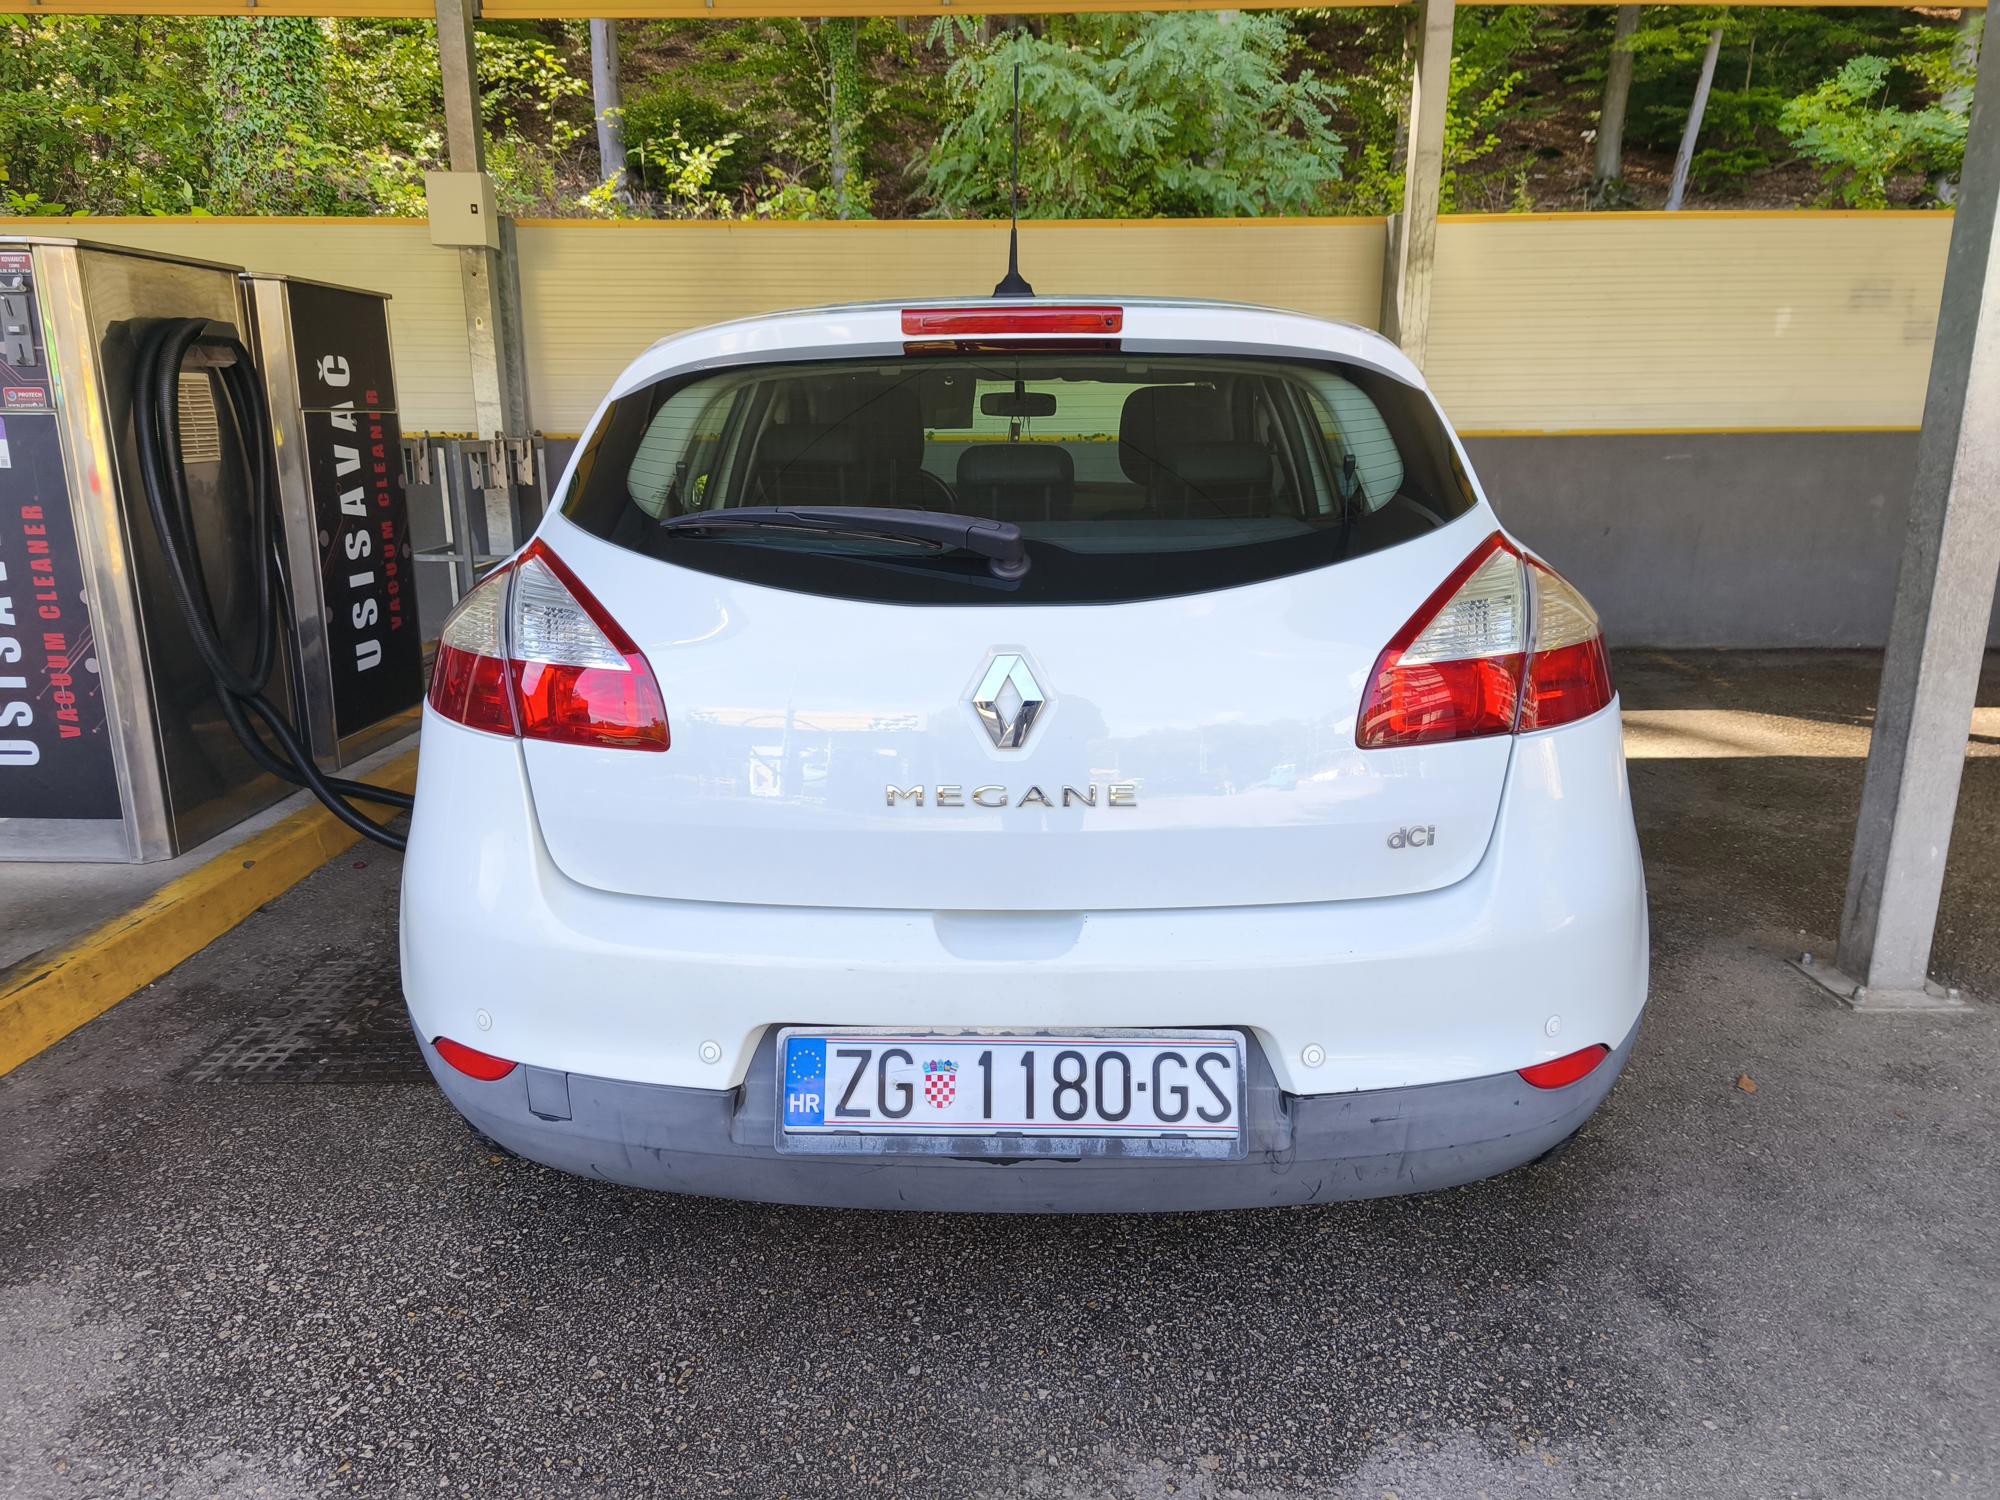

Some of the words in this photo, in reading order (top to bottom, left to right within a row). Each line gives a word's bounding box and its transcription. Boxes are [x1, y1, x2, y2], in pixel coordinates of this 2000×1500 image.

[366, 390, 392, 507] CLEANER
[21, 505, 61, 619] CLEANER
[316, 354, 382, 672] USISAVAČ
[381, 521, 403, 631] VACUUM
[43, 632, 81, 739] VACUUM
[886, 784, 1136, 808] MEGANE
[1386, 824, 1436, 849] dCi
[789, 1093, 820, 1114] HR
[835, 1049, 914, 1118] ZG
